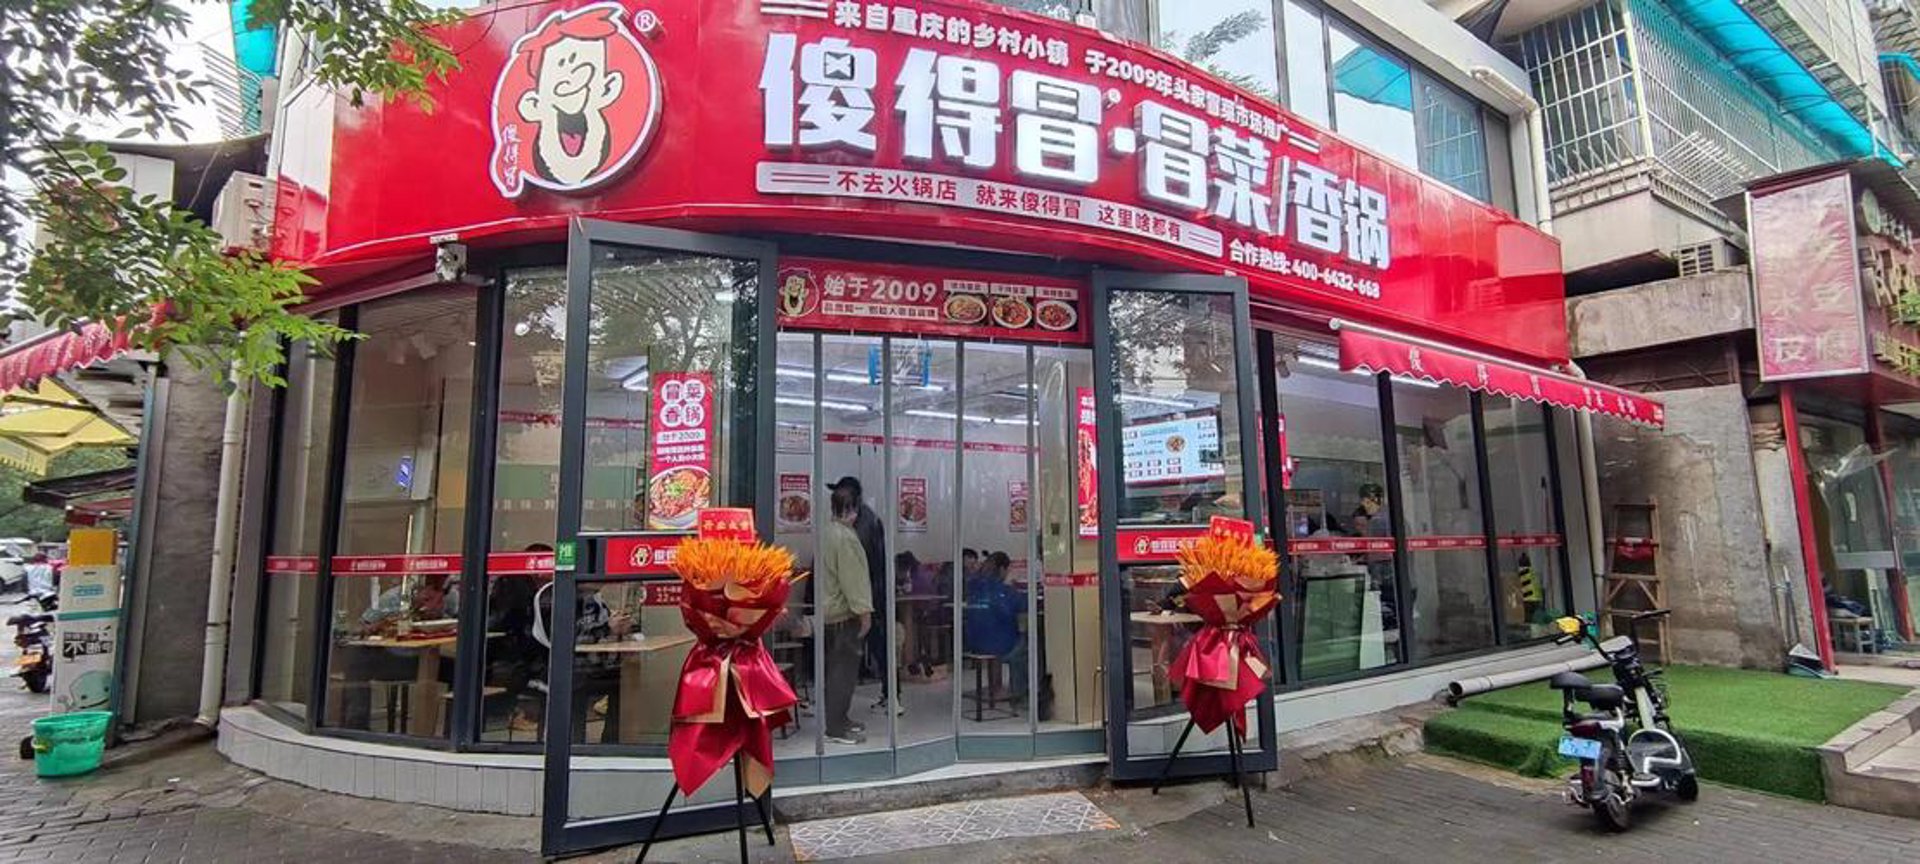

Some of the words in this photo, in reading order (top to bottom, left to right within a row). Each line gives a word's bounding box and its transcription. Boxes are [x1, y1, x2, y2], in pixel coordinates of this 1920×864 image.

[834, 1, 1070, 67] 来自重庆的乡村小镇
[1084, 48, 1290, 143] 于2009年头家冒菜市场推广
[837, 170, 957, 201] 不去火锅店
[976, 184, 1082, 220] 就来傻得冒
[1098, 204, 1182, 242] 这里啥都有
[823, 274, 937, 303] 始于2009
